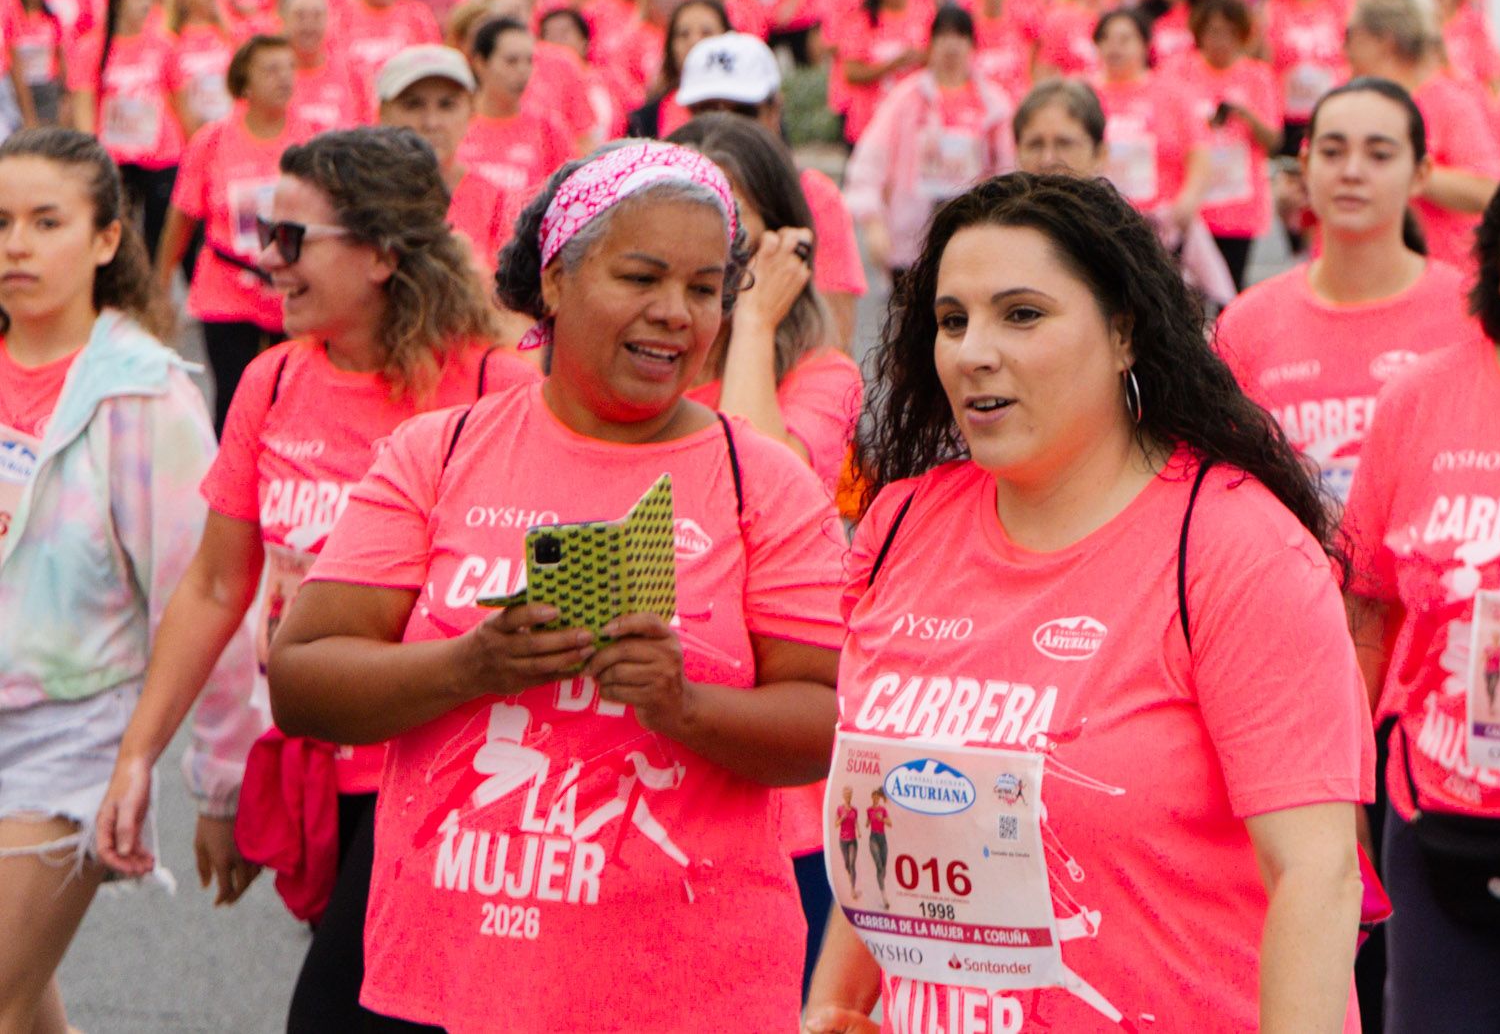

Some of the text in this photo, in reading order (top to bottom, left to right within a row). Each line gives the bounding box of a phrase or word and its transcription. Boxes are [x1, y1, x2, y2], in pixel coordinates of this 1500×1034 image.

[855, 671, 1059, 748] CARRERA
[846, 758, 881, 775] SUMA
[891, 775, 969, 805] ASTURIANA
[433, 828, 607, 905] MUJER
[894, 853, 973, 898] 016
[480, 901, 541, 941] 2026
[918, 901, 956, 921] 1998
[854, 912, 1031, 944] CARRERA DE LA MUJER A CORUÑA
[963, 956, 1032, 975] Santander
